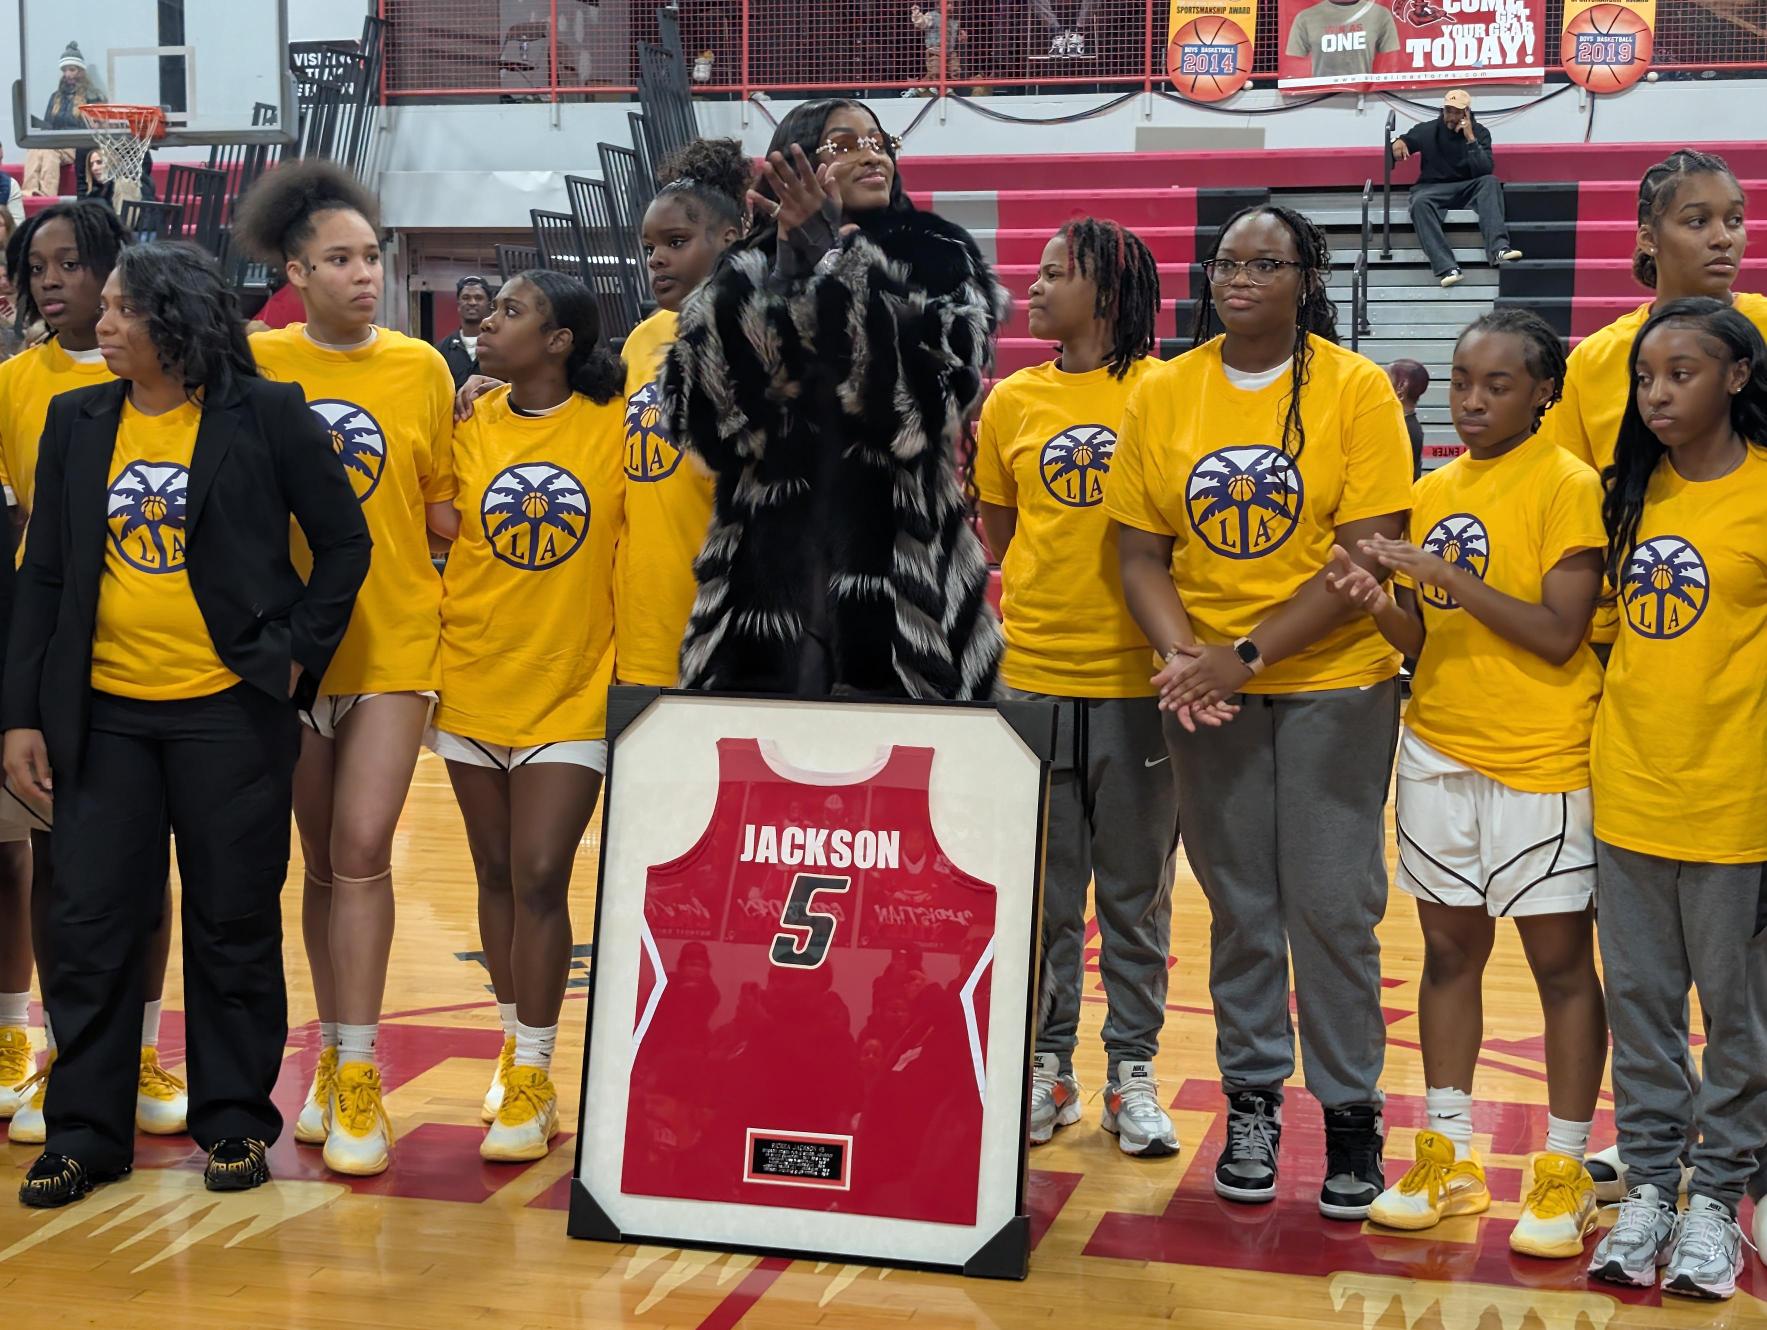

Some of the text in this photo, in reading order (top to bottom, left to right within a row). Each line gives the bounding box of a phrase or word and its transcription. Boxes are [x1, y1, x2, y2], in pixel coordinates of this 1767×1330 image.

[1176, 6, 1226, 14] SPORTSMANSHIP
[1441, 22, 1534, 38] YOUR GEAR
[1321, 31, 1367, 53] ONE
[1596, 35, 1633, 43] BASKETBALL
[1200, 46, 1236, 54] BASKETBALL
[1406, 35, 1536, 67] TODAY!
[1578, 42, 1633, 63] 2019
[1183, 54, 1234, 73] 2014
[1432, 447, 1460, 457] ENTER
[740, 824, 900, 869] JACKSON
[769, 872, 851, 970] 5
[1132, 1064, 1146, 1072] NIKE
